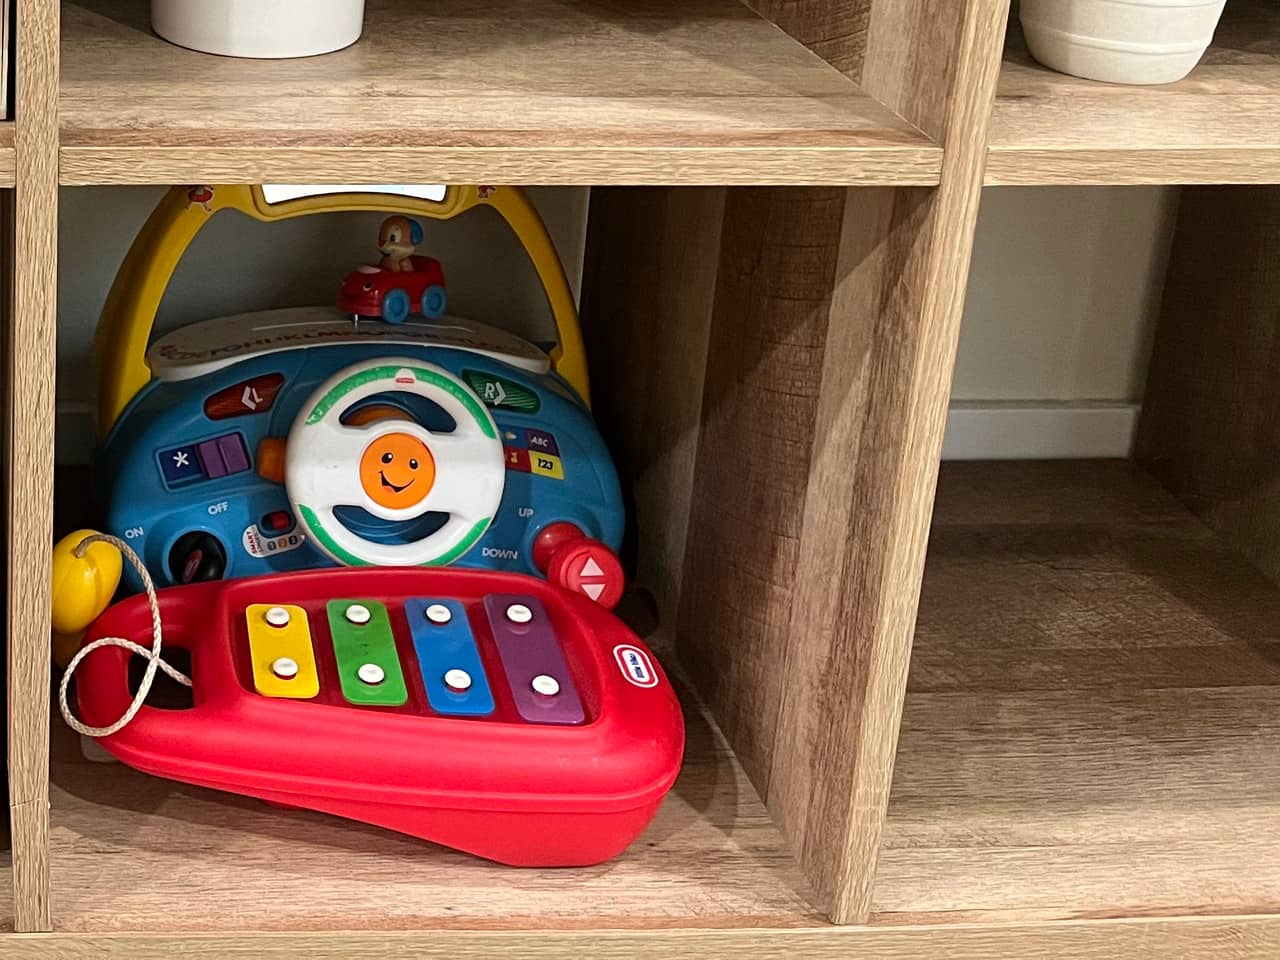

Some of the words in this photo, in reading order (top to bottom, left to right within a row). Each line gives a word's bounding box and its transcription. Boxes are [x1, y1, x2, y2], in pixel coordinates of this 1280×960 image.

[484, 382, 495, 399] R
[531, 436, 549, 447] ABC
[537, 457, 554, 470] 123
[207, 501, 229, 515] OFF
[518, 506, 535, 518] UP
[124, 525, 144, 540] ON
[481, 547, 519, 560] DOWN
